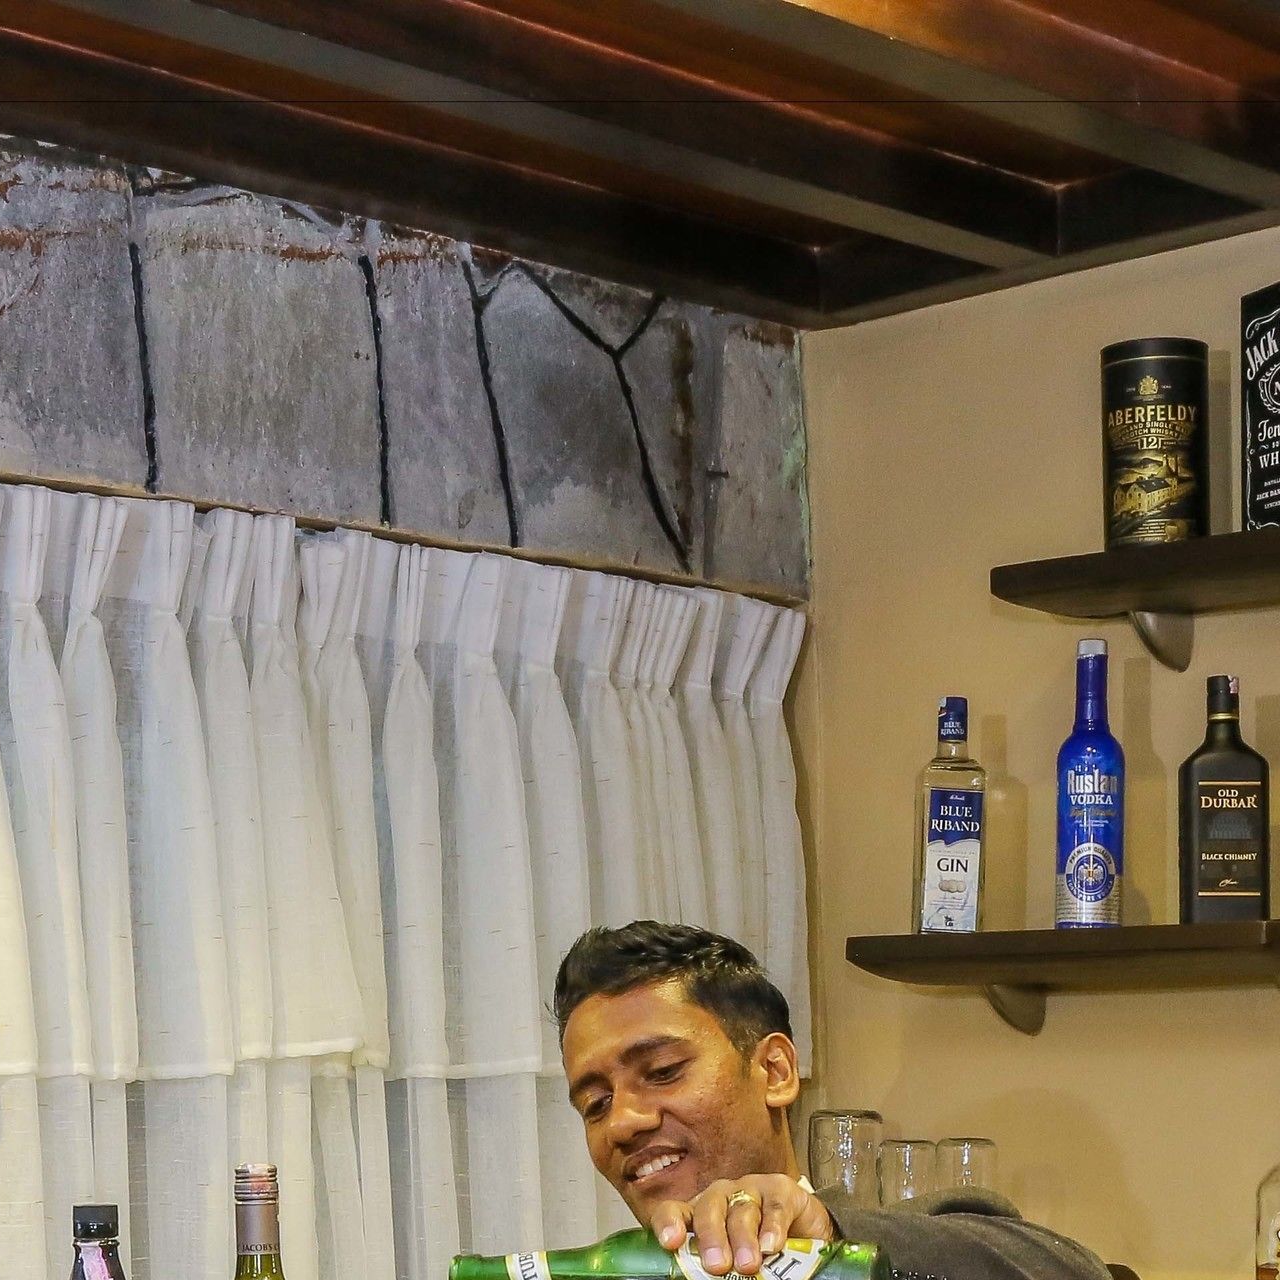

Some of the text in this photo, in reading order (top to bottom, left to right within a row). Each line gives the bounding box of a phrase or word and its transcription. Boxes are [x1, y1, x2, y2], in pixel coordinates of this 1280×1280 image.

[1245, 328, 1279, 380] JACK
[1108, 405, 1197, 428] ABERFELDY
[1141, 437, 1160, 449] 12
[1070, 794, 1113, 805] VODKA
[1218, 789, 1239, 797] OLD
[1200, 795, 1258, 808] DURBAR
[940, 805, 972, 818] BLUE
[931, 819, 980, 832] RIBAND
[1201, 852, 1258, 861] BLACK CHIMNEY
[937, 857, 969, 873] GIN
